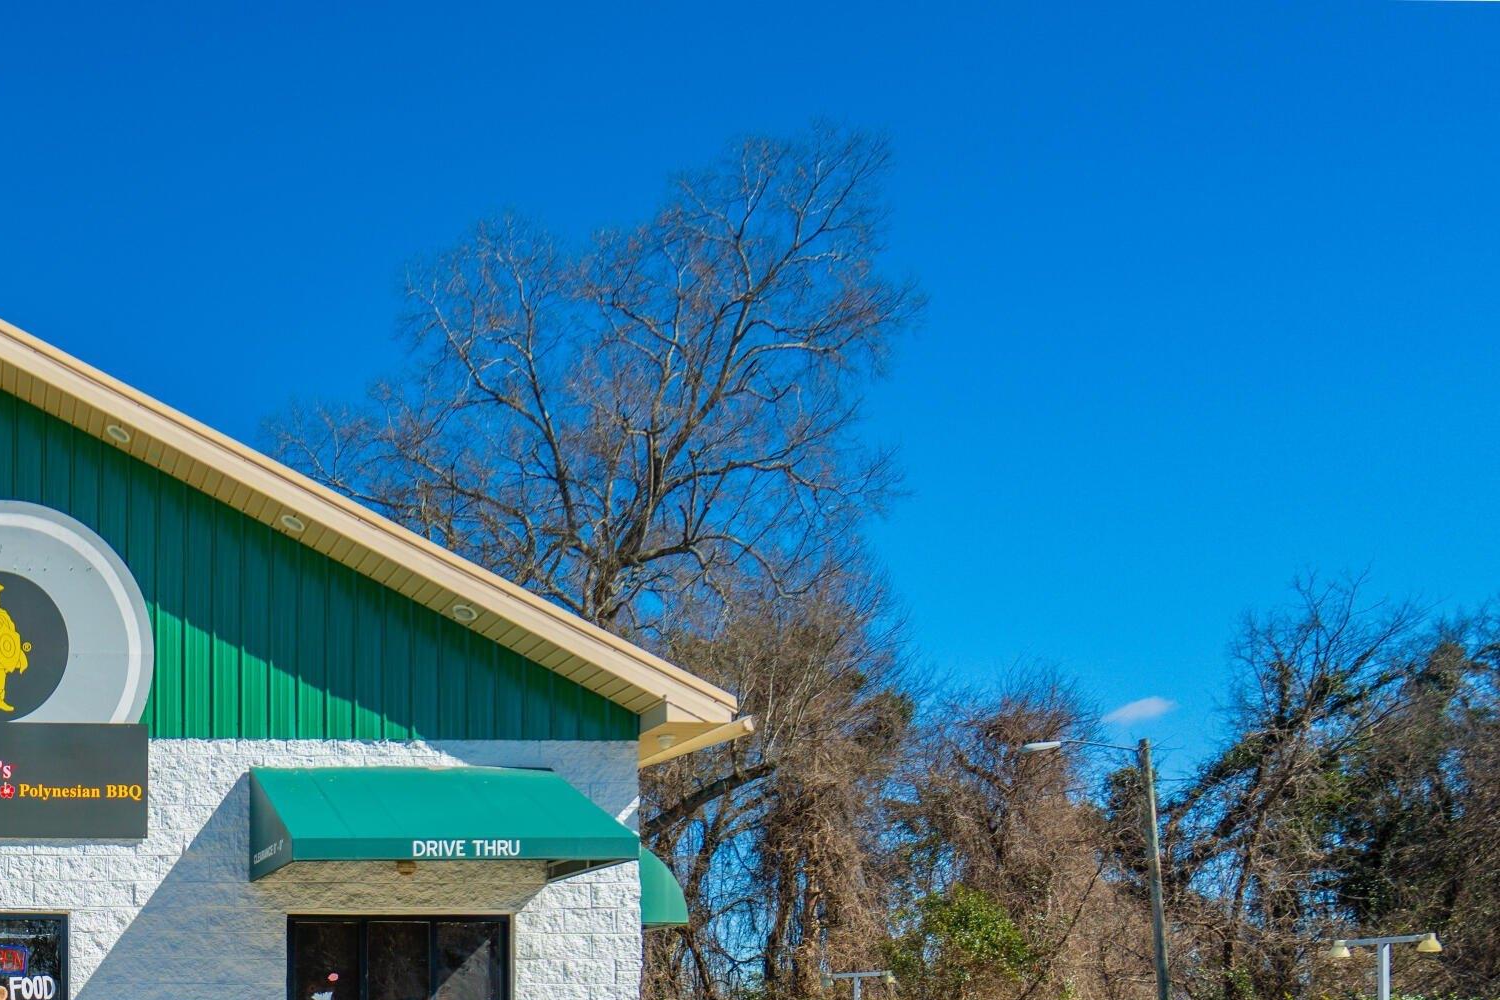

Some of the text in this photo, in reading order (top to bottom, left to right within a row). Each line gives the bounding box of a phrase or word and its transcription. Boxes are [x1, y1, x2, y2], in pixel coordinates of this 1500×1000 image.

[18, 783, 101, 800] Polynesian
[106, 784, 143, 801] BBQ
[412, 839, 521, 857] DRIVE THRU
[8, 975, 56, 1000] FOOD
